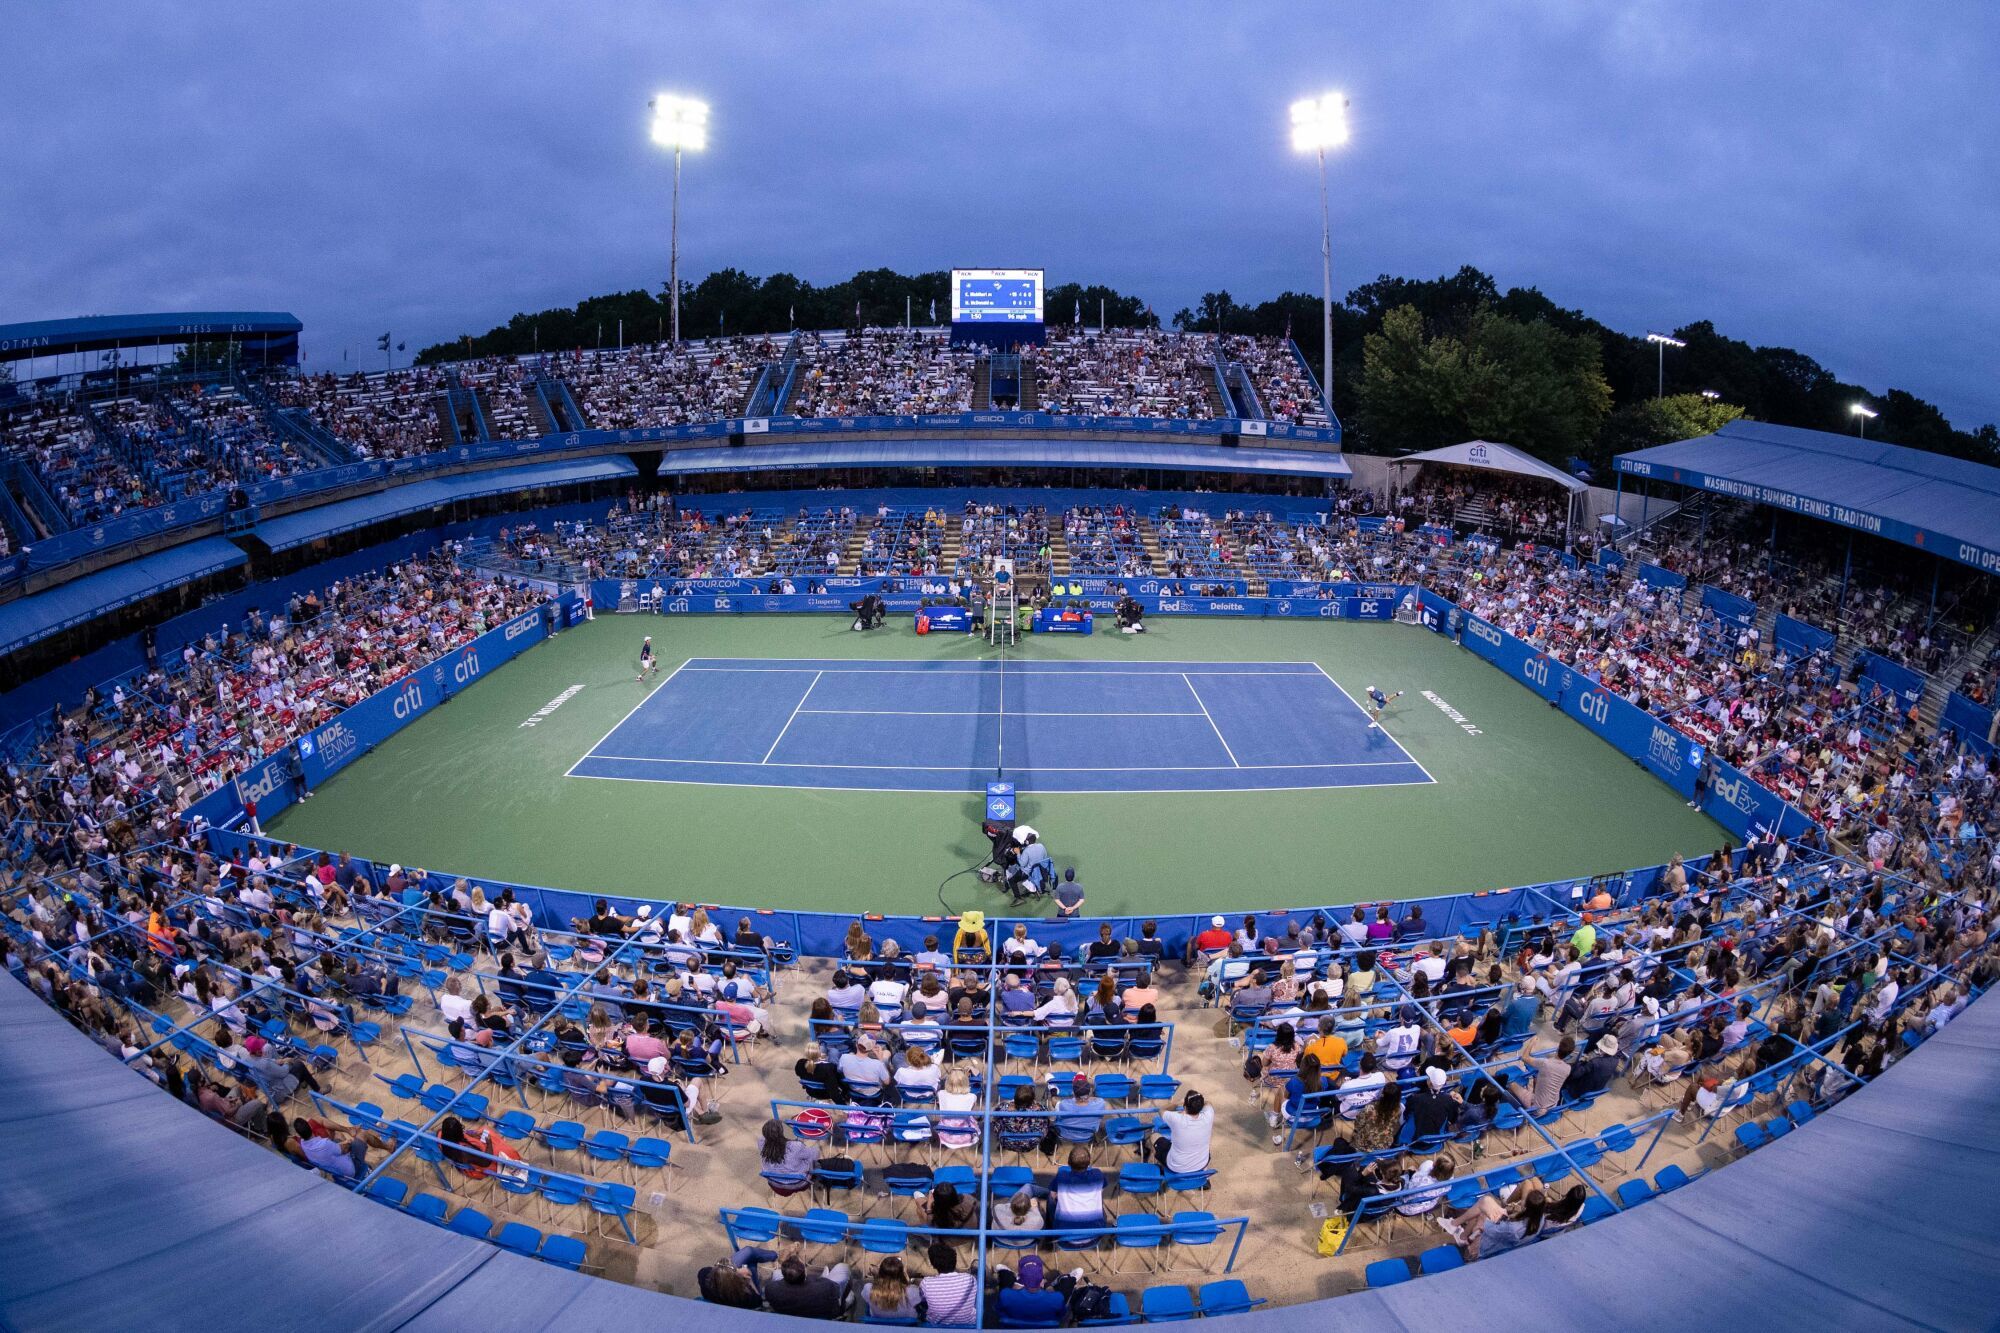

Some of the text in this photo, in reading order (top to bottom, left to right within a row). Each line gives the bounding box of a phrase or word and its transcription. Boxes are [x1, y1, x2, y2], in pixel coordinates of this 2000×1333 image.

[180, 324, 211, 334] PRESS
[1019, 415, 1034, 424] citi
[566, 434, 580, 446] citi
[1470, 446, 1486, 457] citi
[1621, 460, 1650, 474] CITI OPEN
[1704, 476, 1881, 532] WASHINGTON'S SUMMER TENNIS TRADITION
[1959, 545, 1980, 565] CITI
[1140, 582, 1158, 593] citi
[669, 599, 688, 612] citi
[715, 599, 731, 608] DC
[1210, 602, 1245, 611] Deloitte.
[1320, 602, 1340, 616] citi
[1360, 602, 1378, 613] DC
[505, 612, 539, 640] GEICO
[1468, 618, 1502, 646] GEICO
[455, 652, 479, 683] citi
[1524, 658, 1548, 686] citi
[394, 684, 422, 718] citi
[1580, 692, 1608, 725] citi
[316, 722, 347, 747] MDE.
[318, 730, 356, 763] TENNIS
[1652, 726, 1678, 753] MDE.
[1649, 738, 1682, 771] TENNIS
[239, 762, 292, 802] FedEx
[1706, 764, 1760, 815] FedEx
